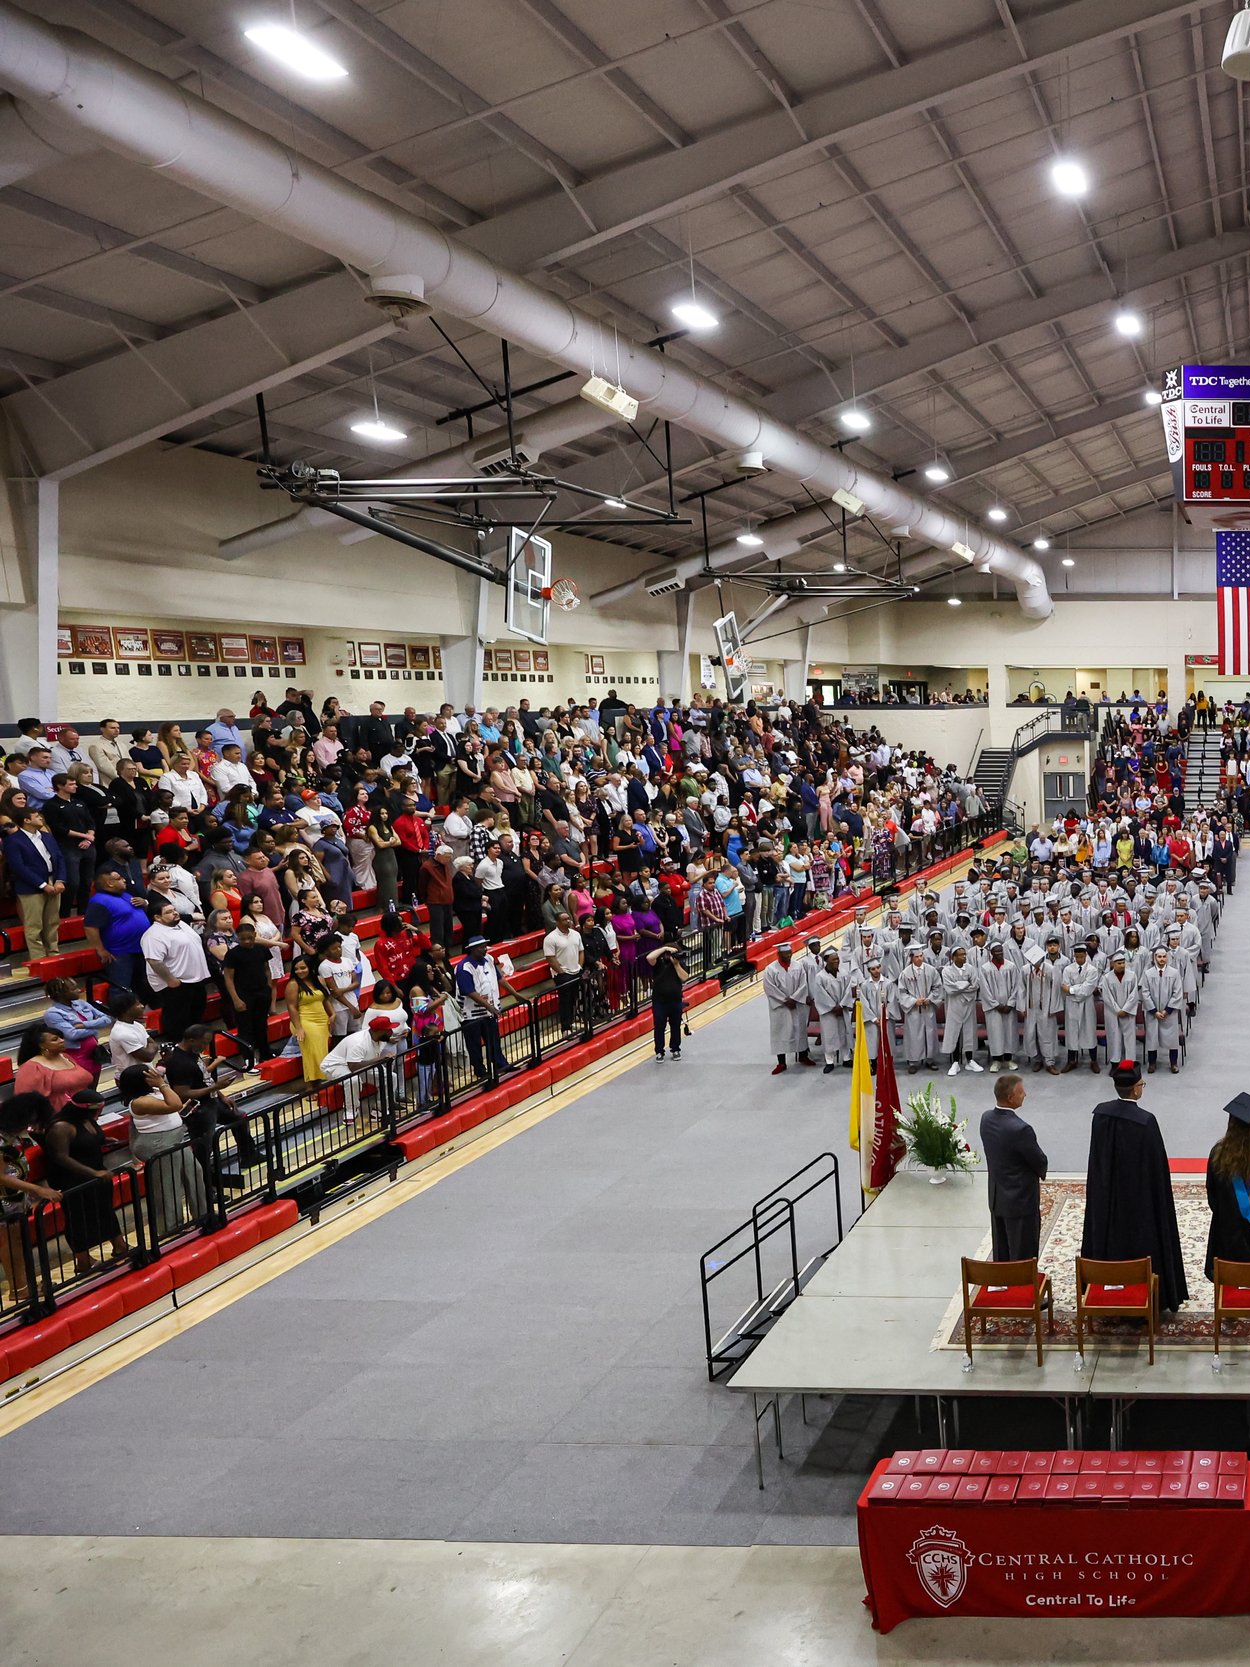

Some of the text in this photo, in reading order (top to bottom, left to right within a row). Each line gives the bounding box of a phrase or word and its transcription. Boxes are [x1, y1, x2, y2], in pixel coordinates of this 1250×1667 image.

[1189, 376, 1218, 386] TDC
[1162, 386, 1181, 400] TDC
[1190, 405, 1226, 414] Central
[1192, 416, 1223, 425] To Life
[923, 1554, 958, 1565] CCHS
[978, 1552, 1194, 1567] CENTRAL CATHOLIC
[1005, 1571, 1169, 1582] HIGH SCHOOL
[1025, 1594, 1137, 1607] Central To Life
